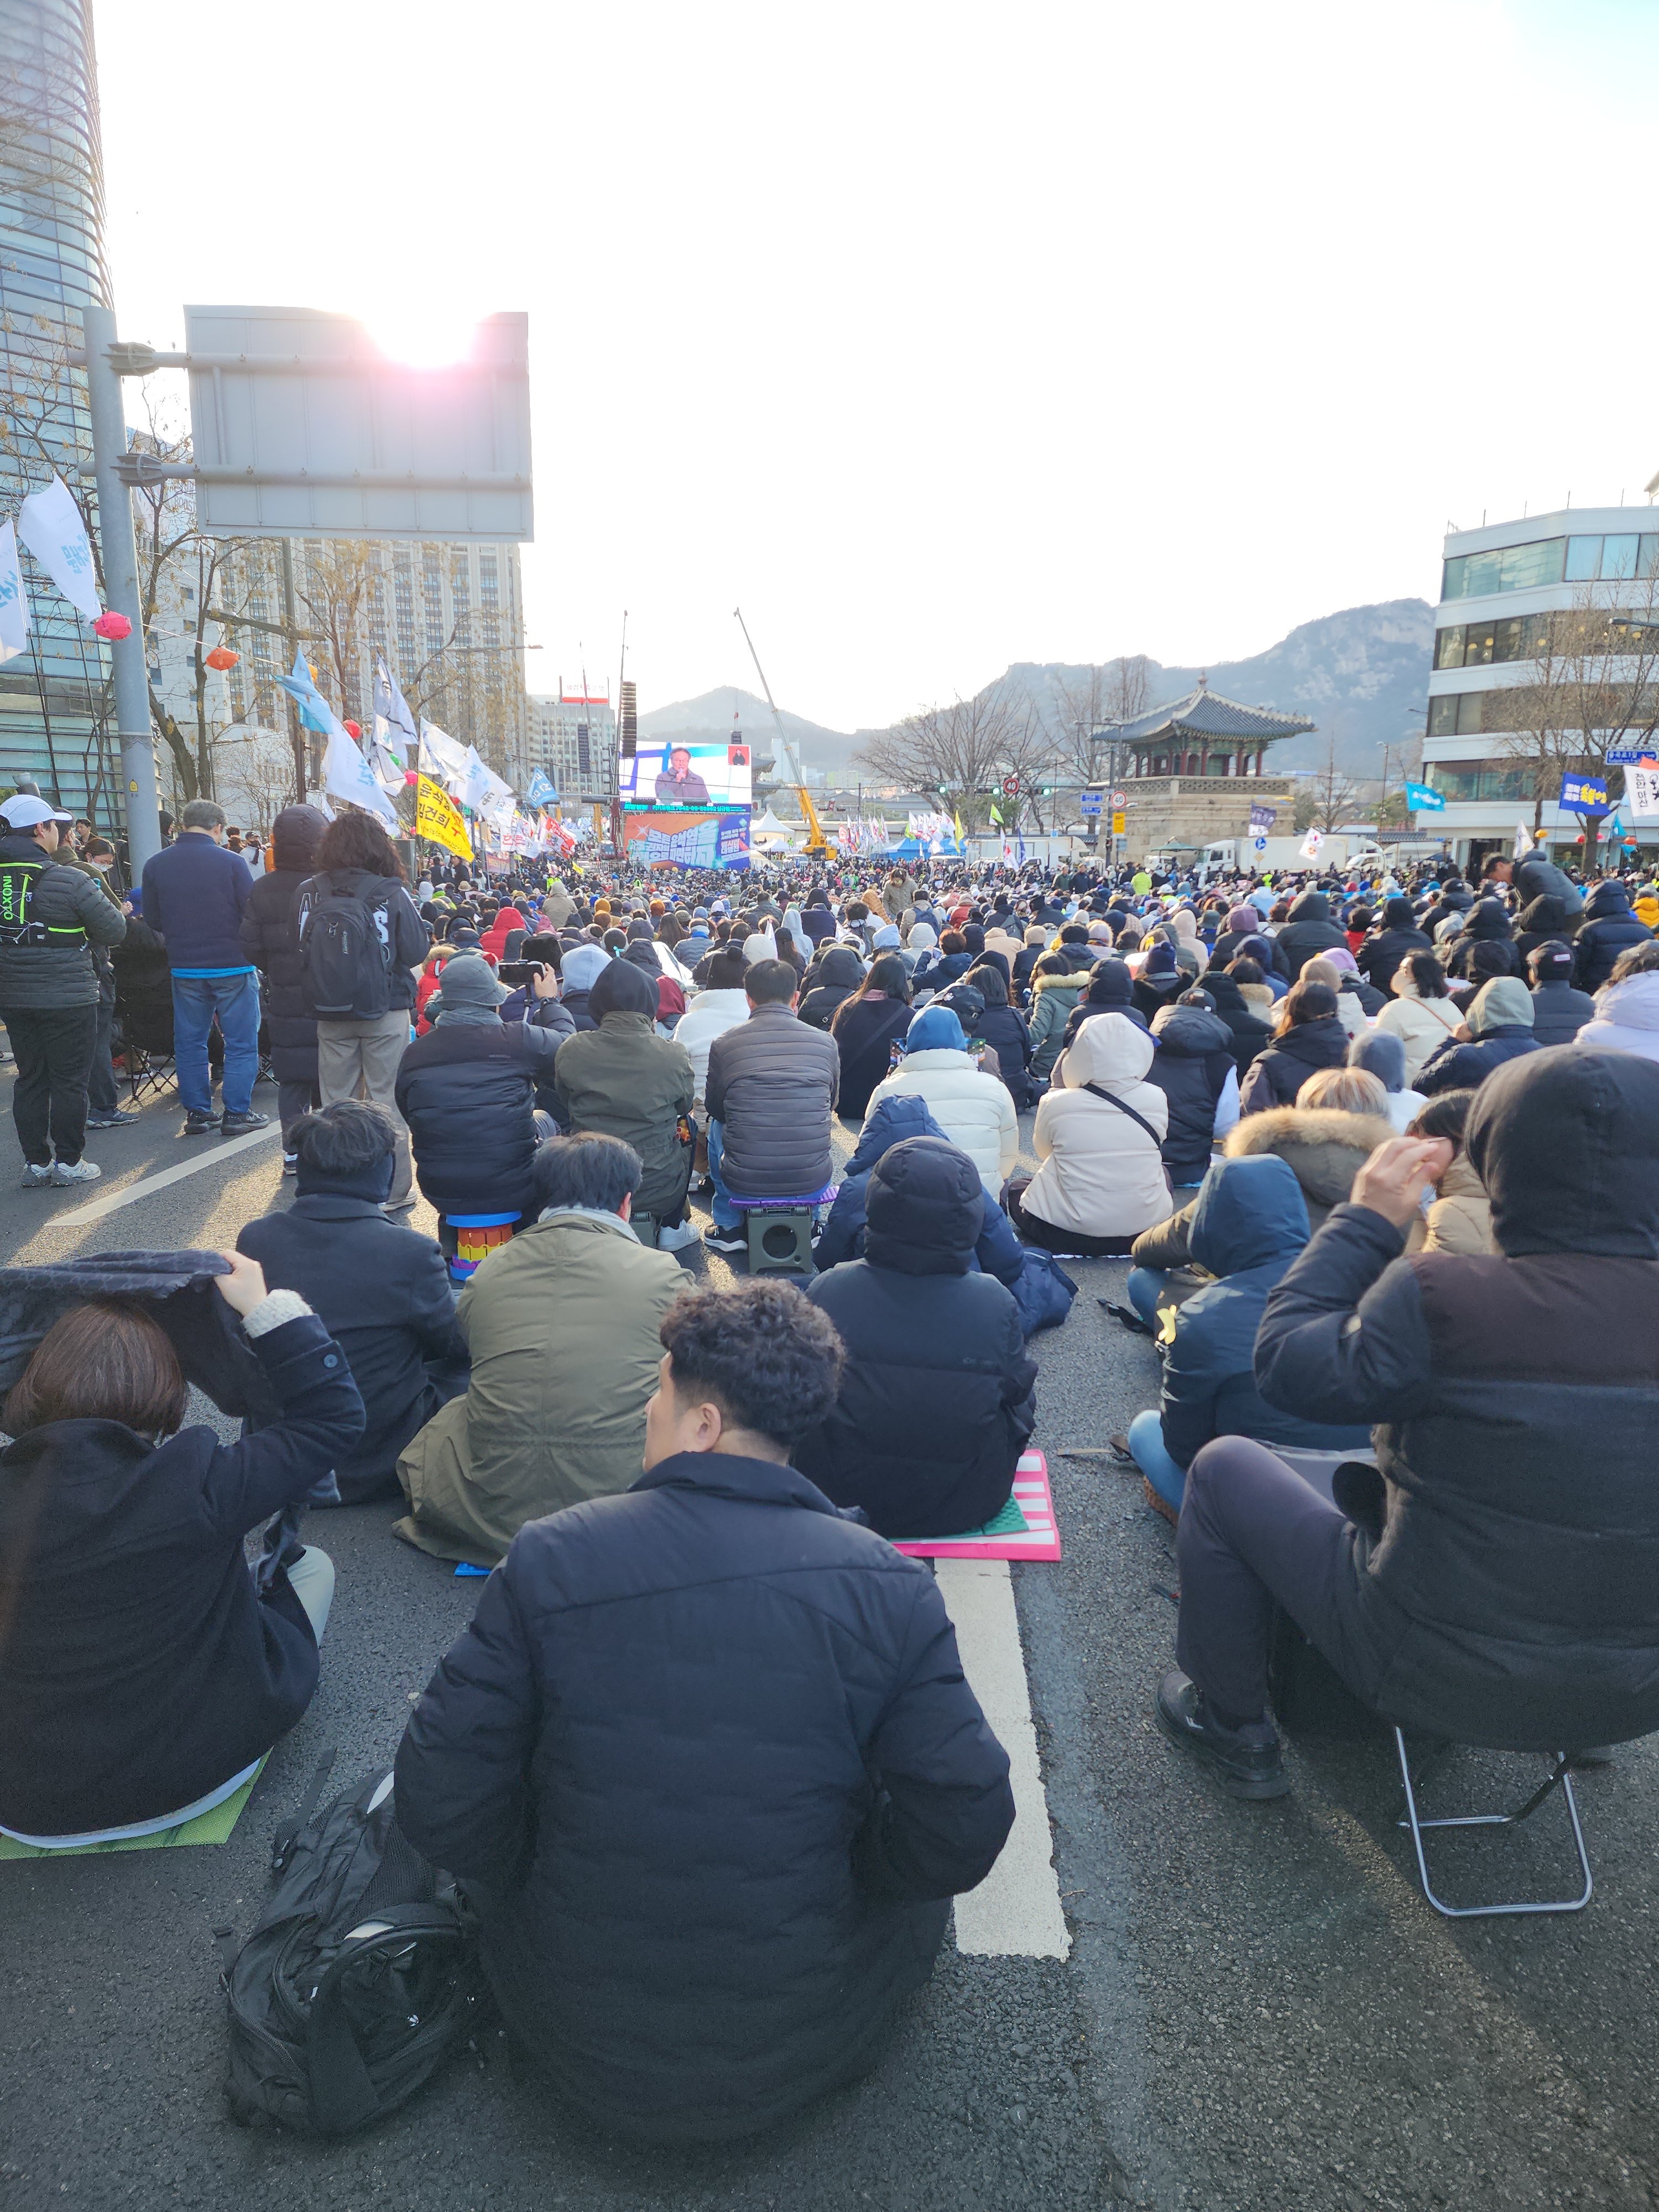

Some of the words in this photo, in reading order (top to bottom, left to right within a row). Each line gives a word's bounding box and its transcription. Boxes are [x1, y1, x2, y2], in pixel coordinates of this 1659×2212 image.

[670, 819, 719, 848] 윤석열을
[669, 844, 716, 869] 파면하자
[2, 875, 13, 920] INOXTO
